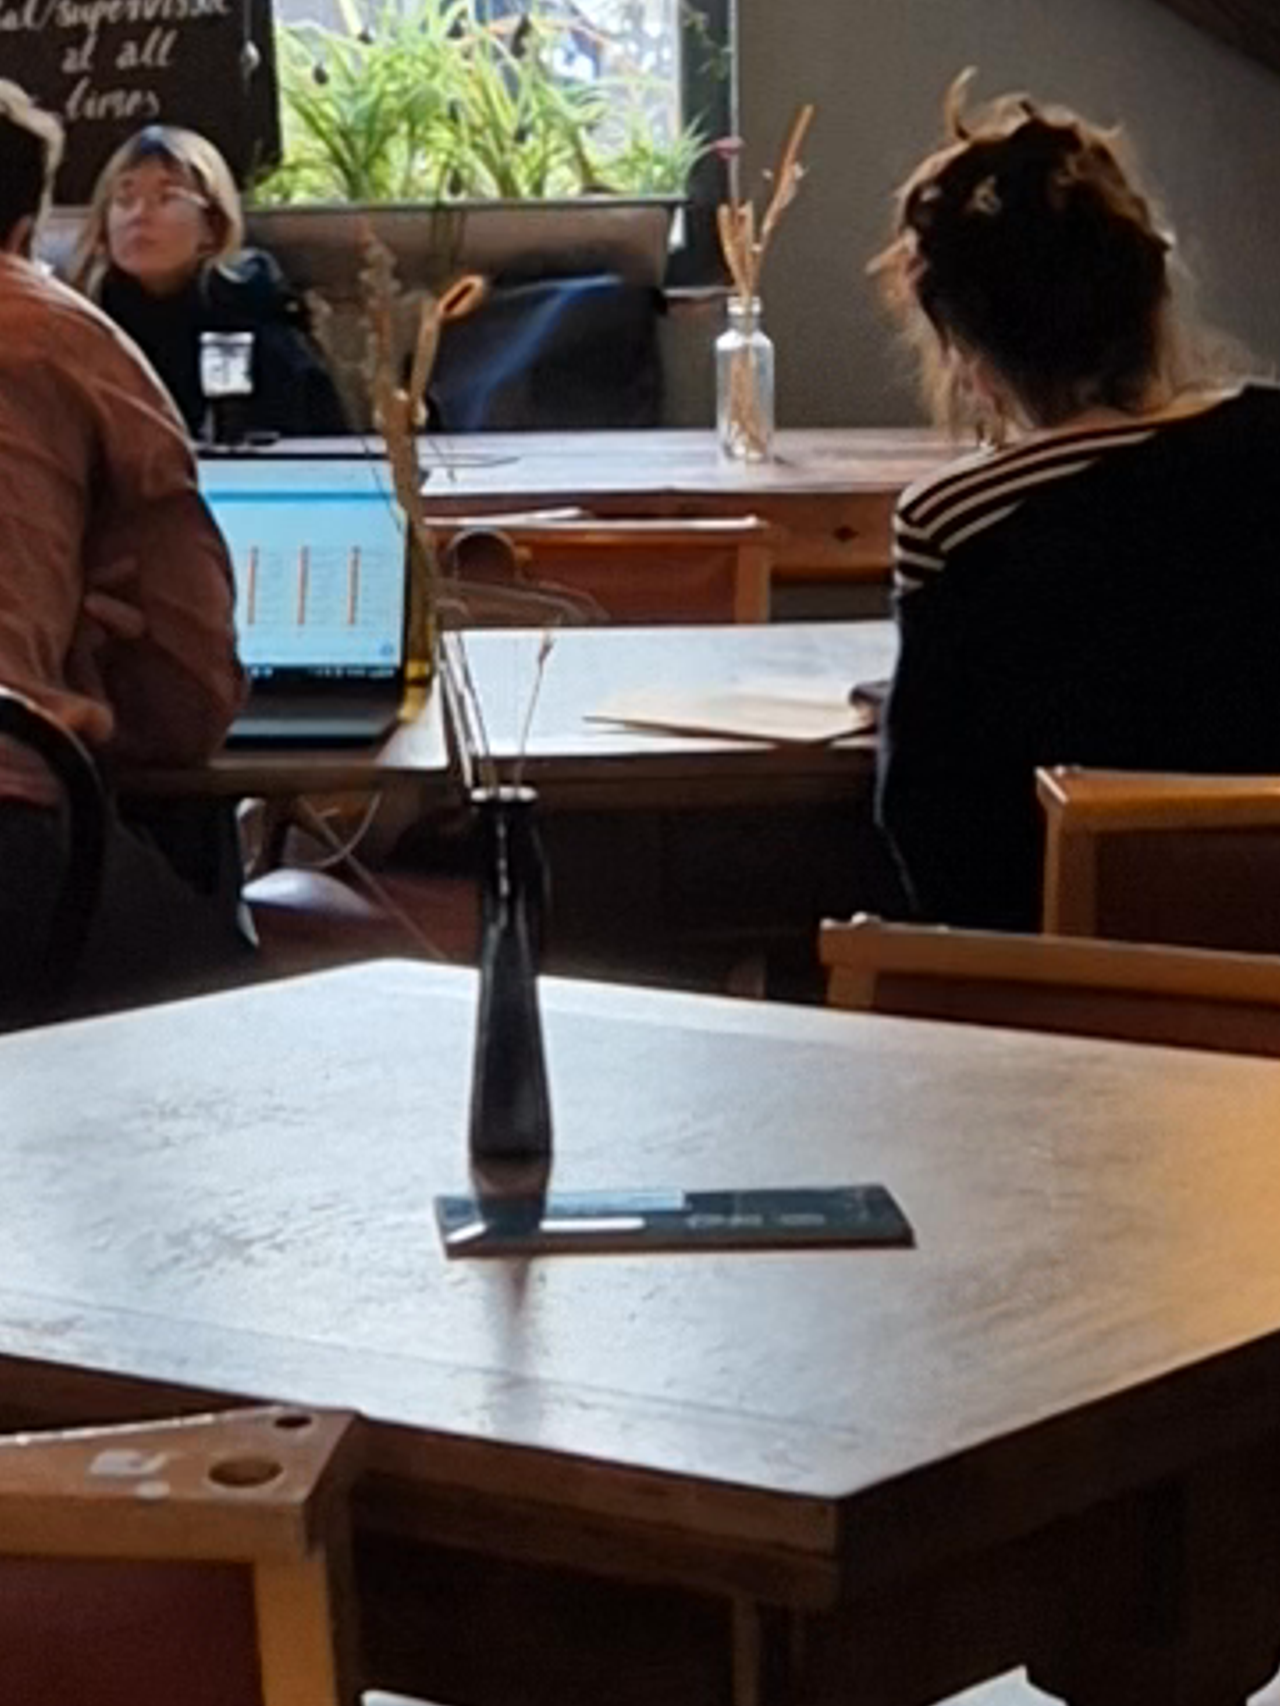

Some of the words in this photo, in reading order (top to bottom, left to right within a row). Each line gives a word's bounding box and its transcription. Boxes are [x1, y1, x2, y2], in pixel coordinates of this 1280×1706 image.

[61, 32, 99, 74] at
[115, 26, 179, 71] all
[65, 76, 161, 121] times
